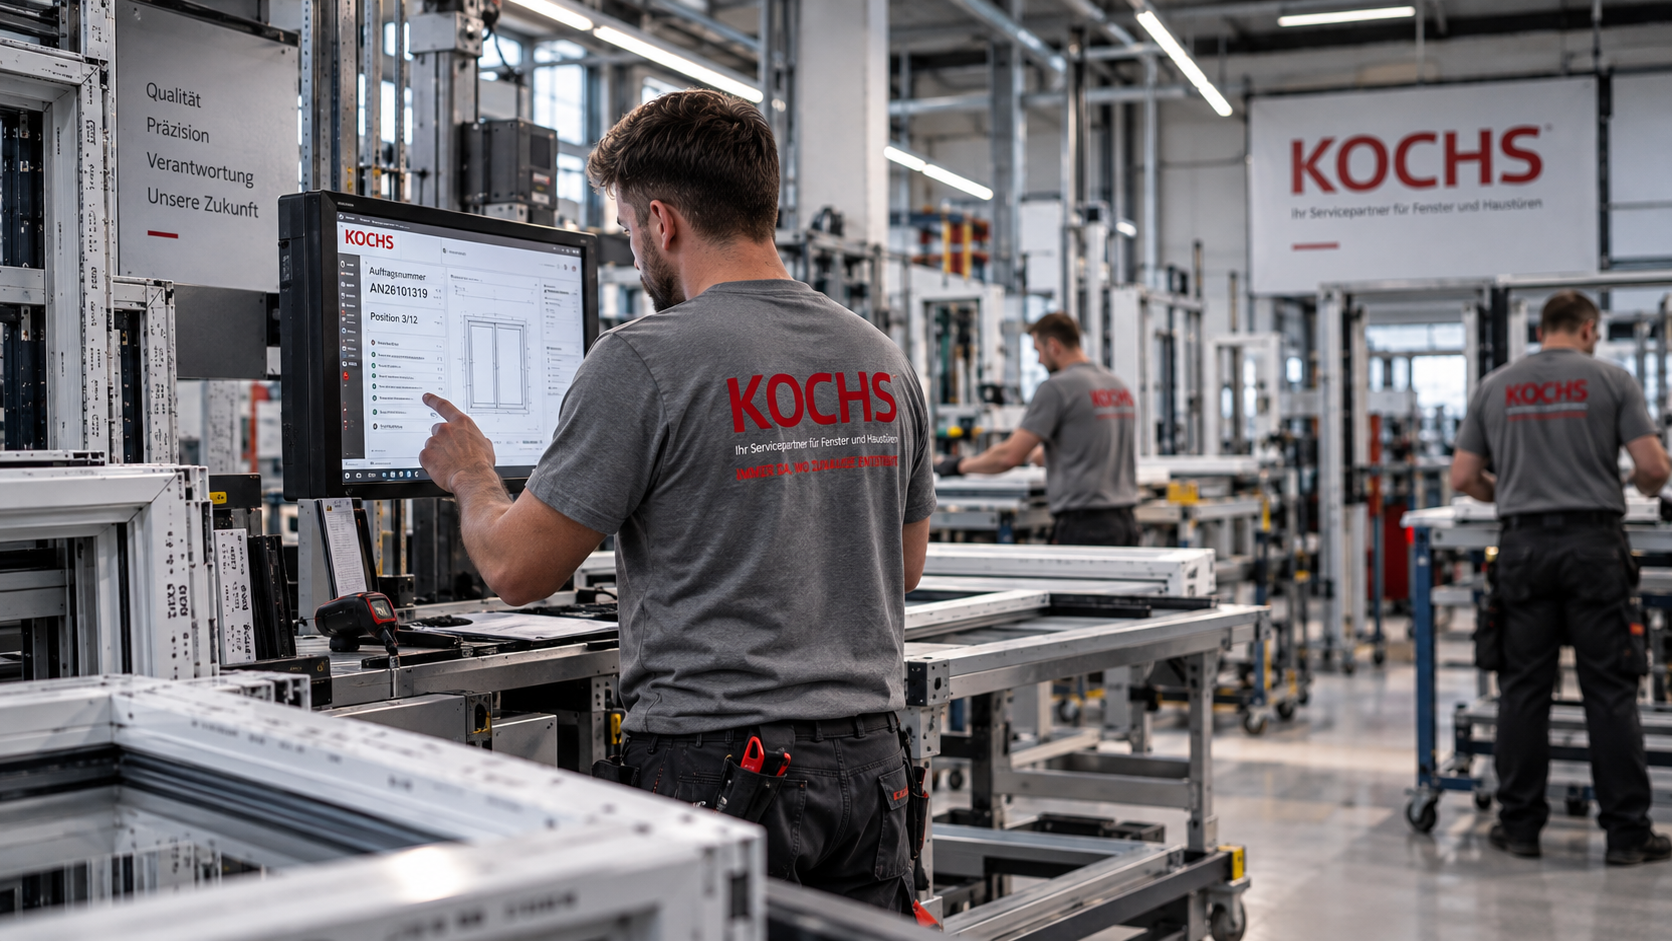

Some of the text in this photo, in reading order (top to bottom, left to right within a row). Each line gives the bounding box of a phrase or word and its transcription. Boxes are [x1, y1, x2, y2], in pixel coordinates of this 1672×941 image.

[146, 82, 201, 108] Qualität
[147, 117, 209, 143] Präzision
[147, 152, 254, 189] Verantwortung
[1290, 124, 1544, 195] KOCHS
[148, 187, 259, 218] Unsere Zukunft
[1291, 197, 1543, 220] Ihr Servicepartner für Fenster und Haustüren
[345, 229, 394, 250] KOCHS
[369, 266, 426, 281] Auftragsnummer
[370, 282, 428, 299] AN26101319
[370, 312, 418, 325] Position 3/12
[726, 371, 897, 433] KOCHS
[1505, 378, 1589, 407] KOCHS
[735, 445, 748, 455] Ihr
[750, 440, 808, 454] Servicepartner
[809, 436, 819, 448] für
[821, 437, 850, 447] Fenster
[851, 434, 866, 445] und
